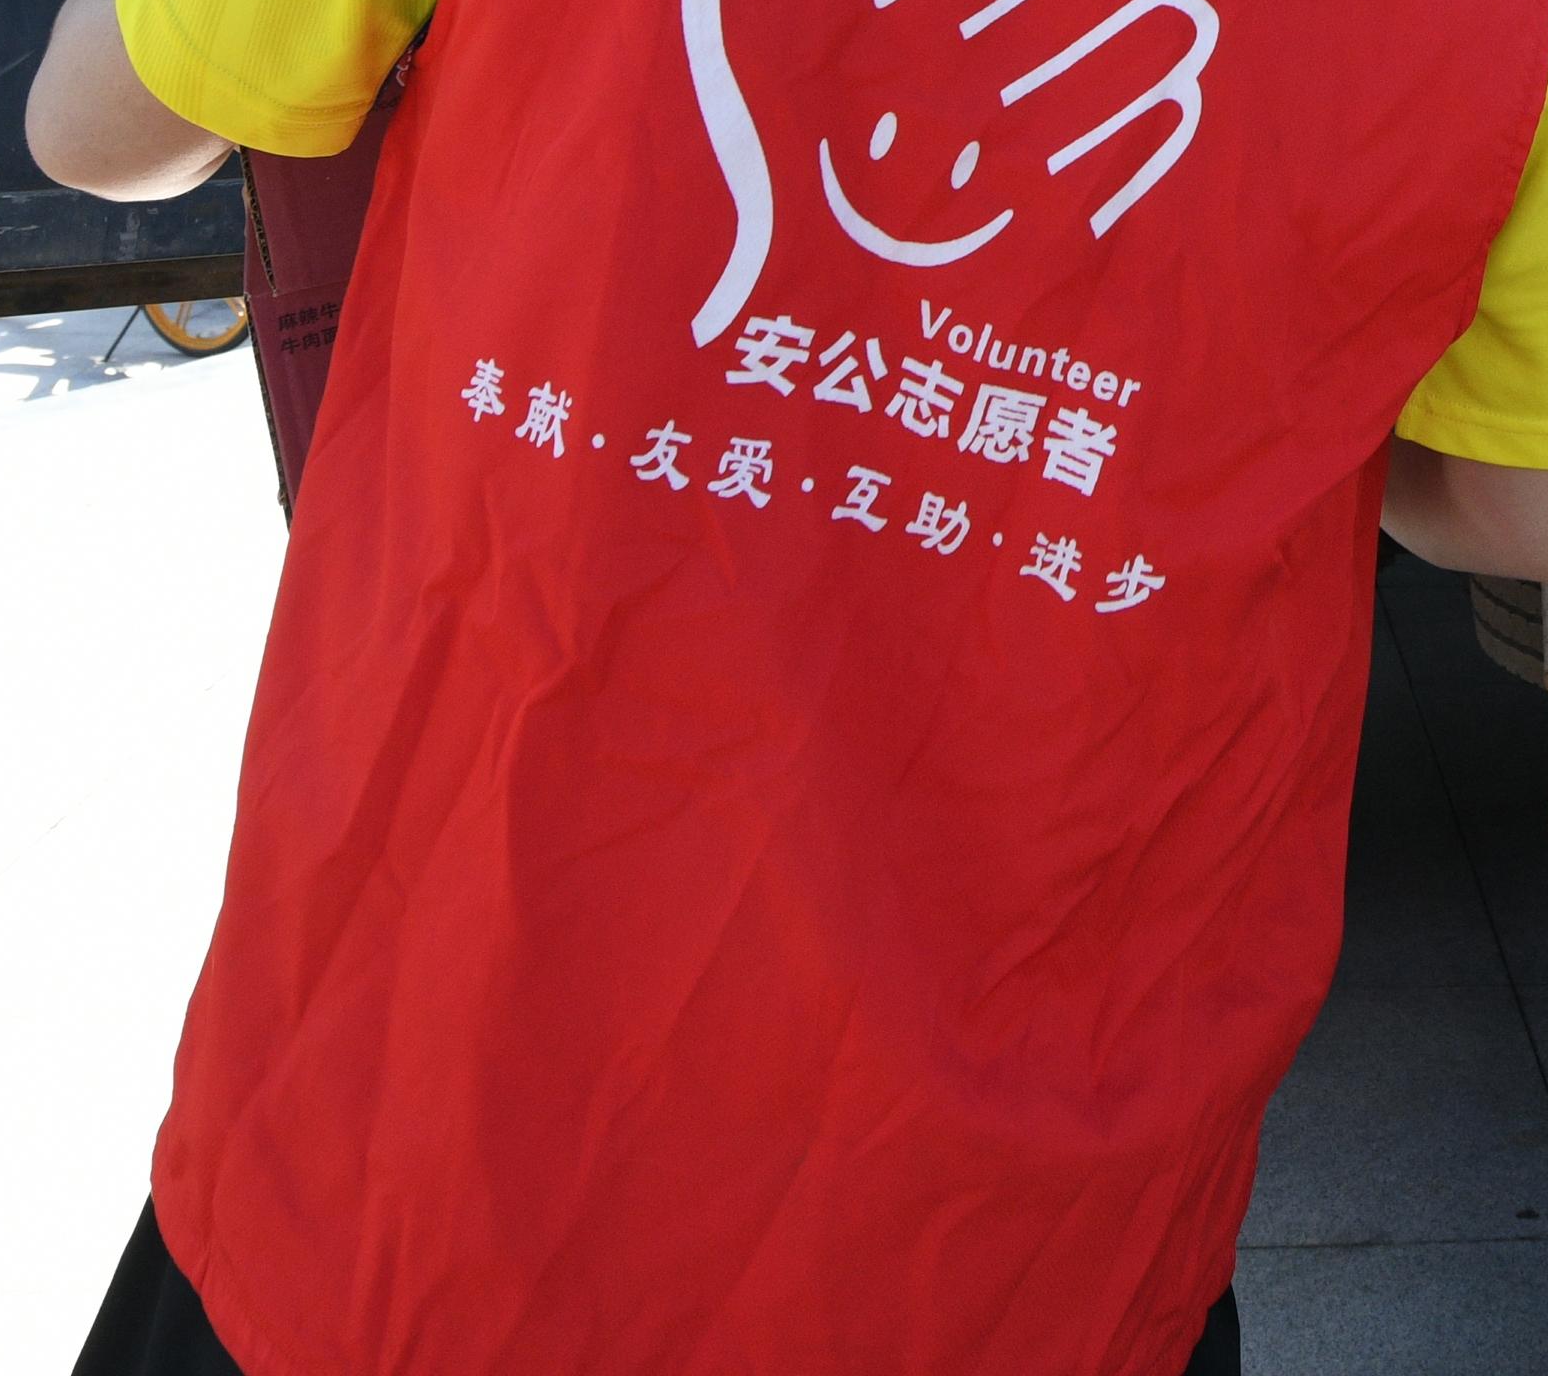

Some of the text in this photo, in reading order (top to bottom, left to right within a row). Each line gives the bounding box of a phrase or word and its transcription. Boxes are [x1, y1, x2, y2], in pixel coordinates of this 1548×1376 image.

[724, 314, 1119, 498] 安公志愿者
[918, 298, 1144, 409] Volunteer
